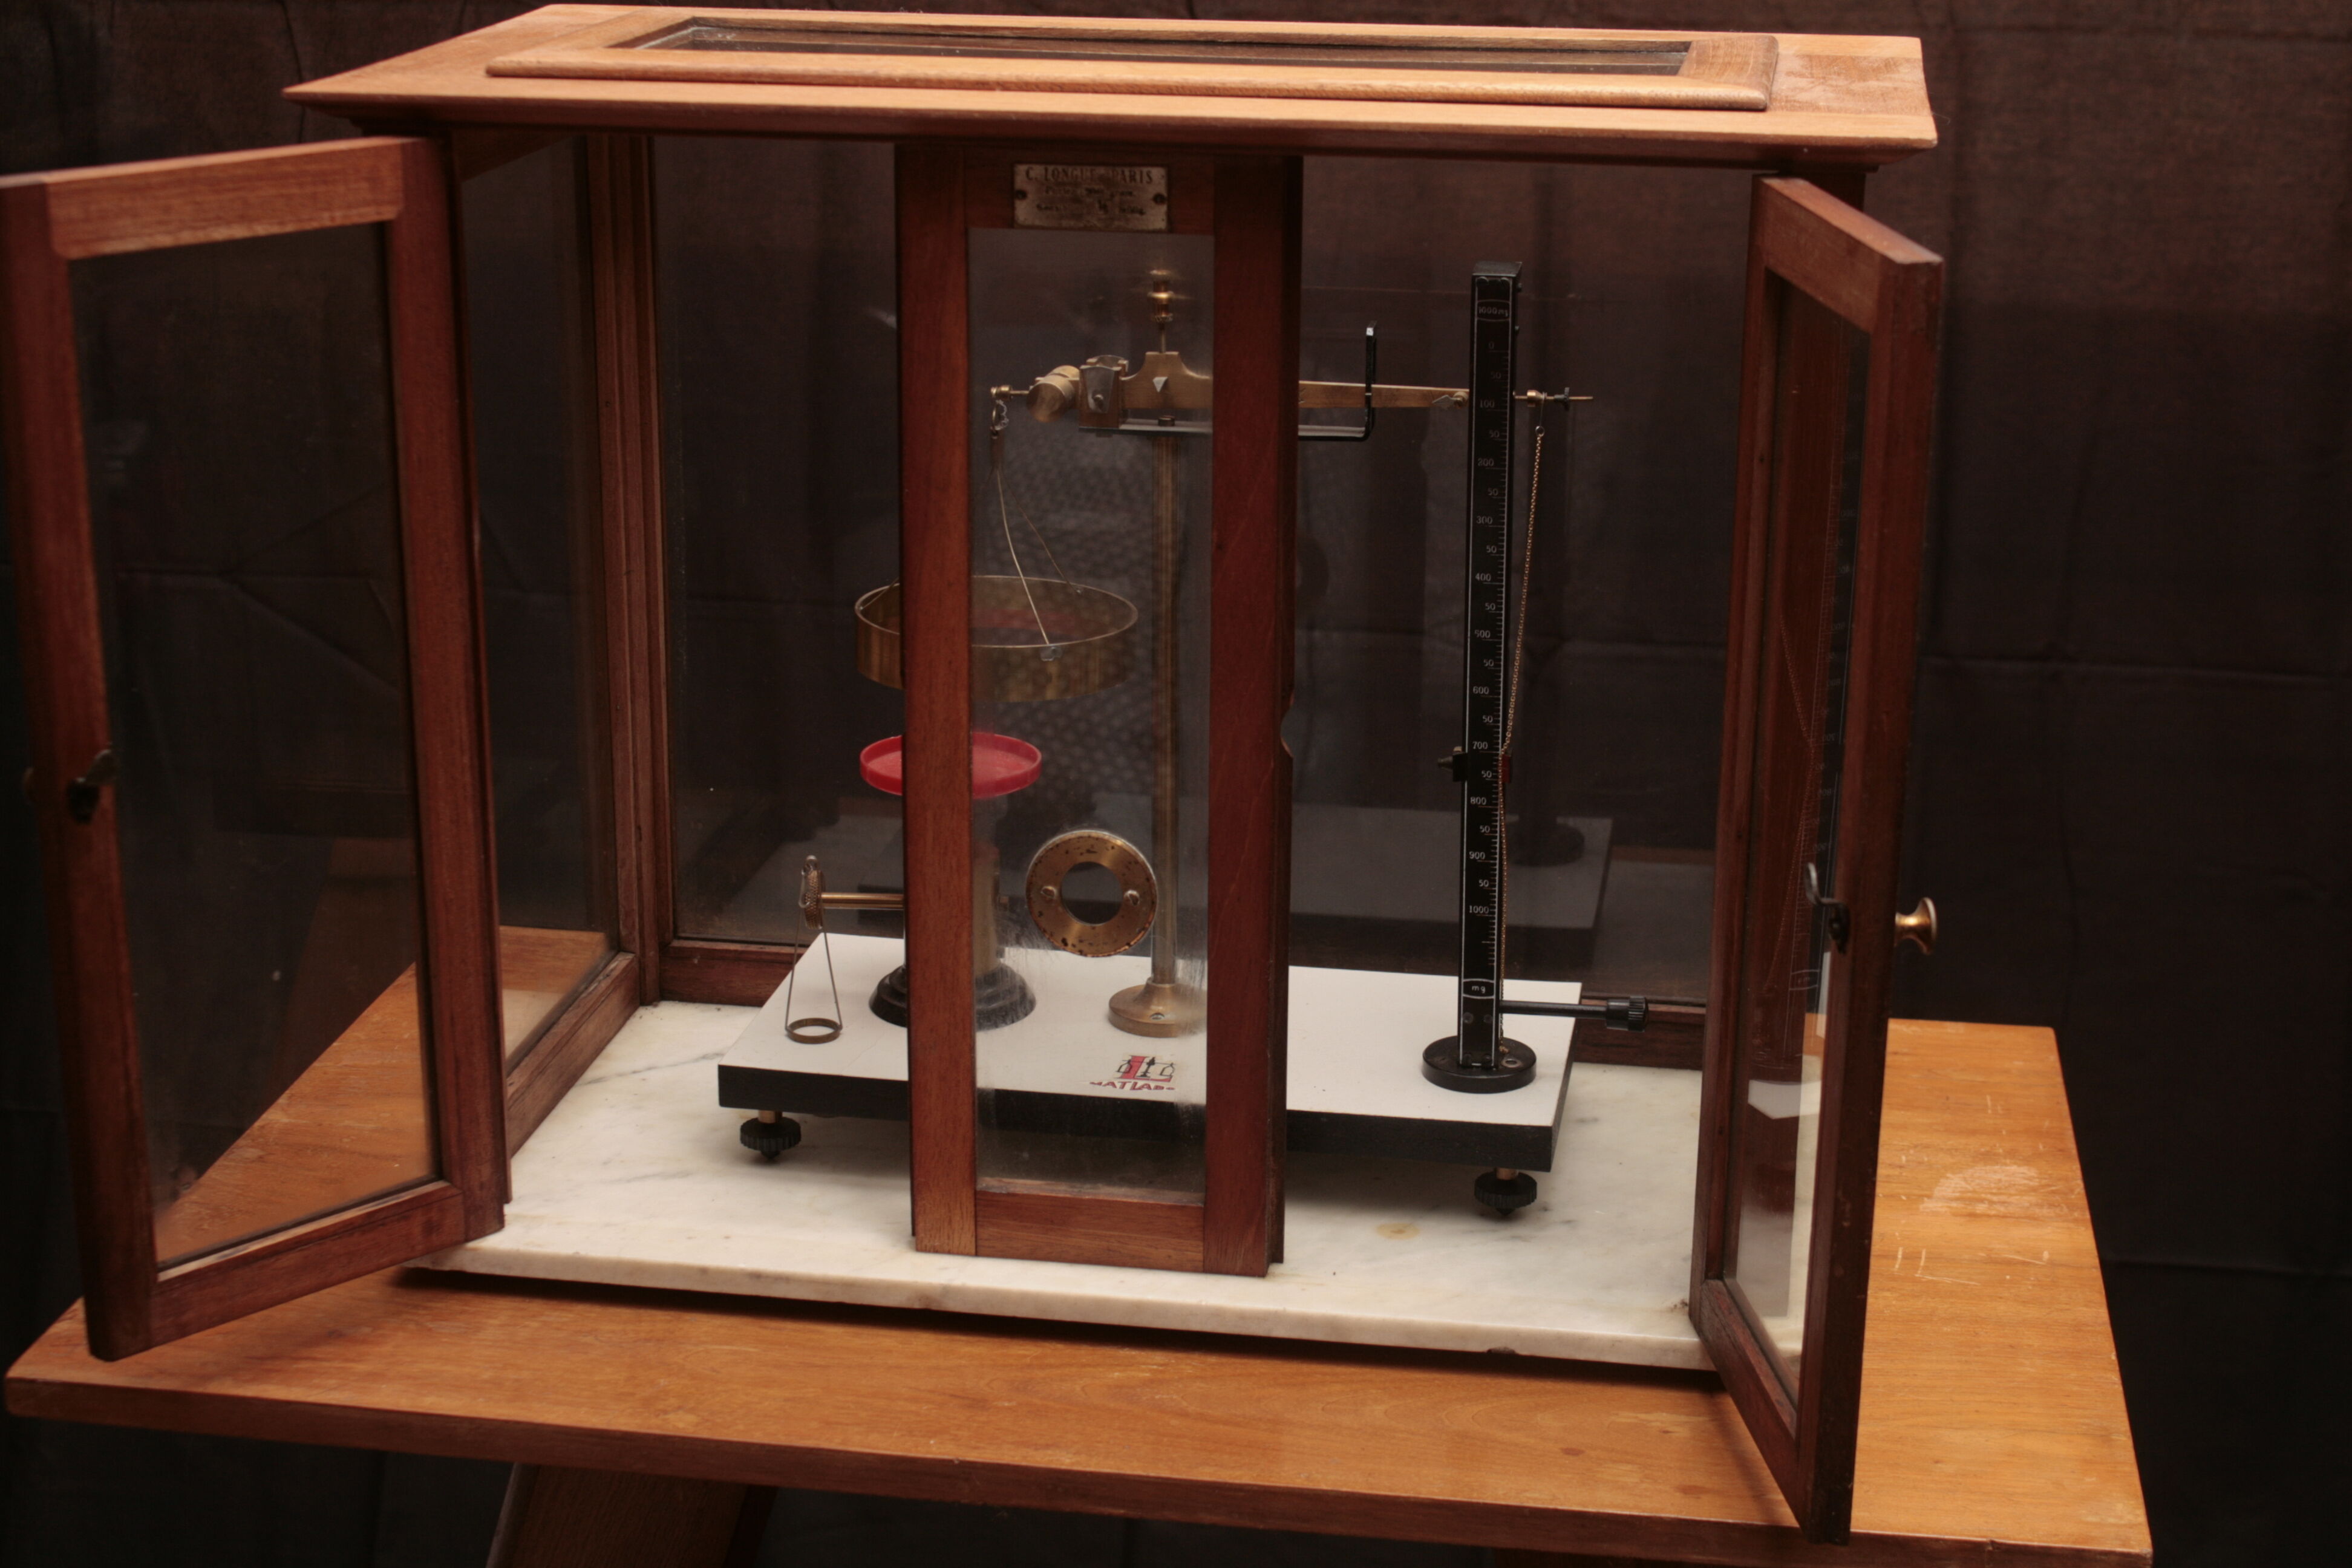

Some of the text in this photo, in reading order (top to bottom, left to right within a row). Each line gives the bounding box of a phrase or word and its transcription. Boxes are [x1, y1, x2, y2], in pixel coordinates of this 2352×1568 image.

[1112, 169, 1152, 184] PARIS
[1477, 458, 1494, 466] 200
[1476, 515, 1493, 524] 300
[1475, 573, 1491, 581] 400
[1474, 630, 1491, 638] 500
[1472, 686, 1489, 694] 600
[1472, 741, 1488, 750] 700
[1470, 797, 1486, 805] 800
[1469, 851, 1485, 860] 900
[1469, 905, 1489, 913] 1000
[1471, 985, 1486, 993] mg
